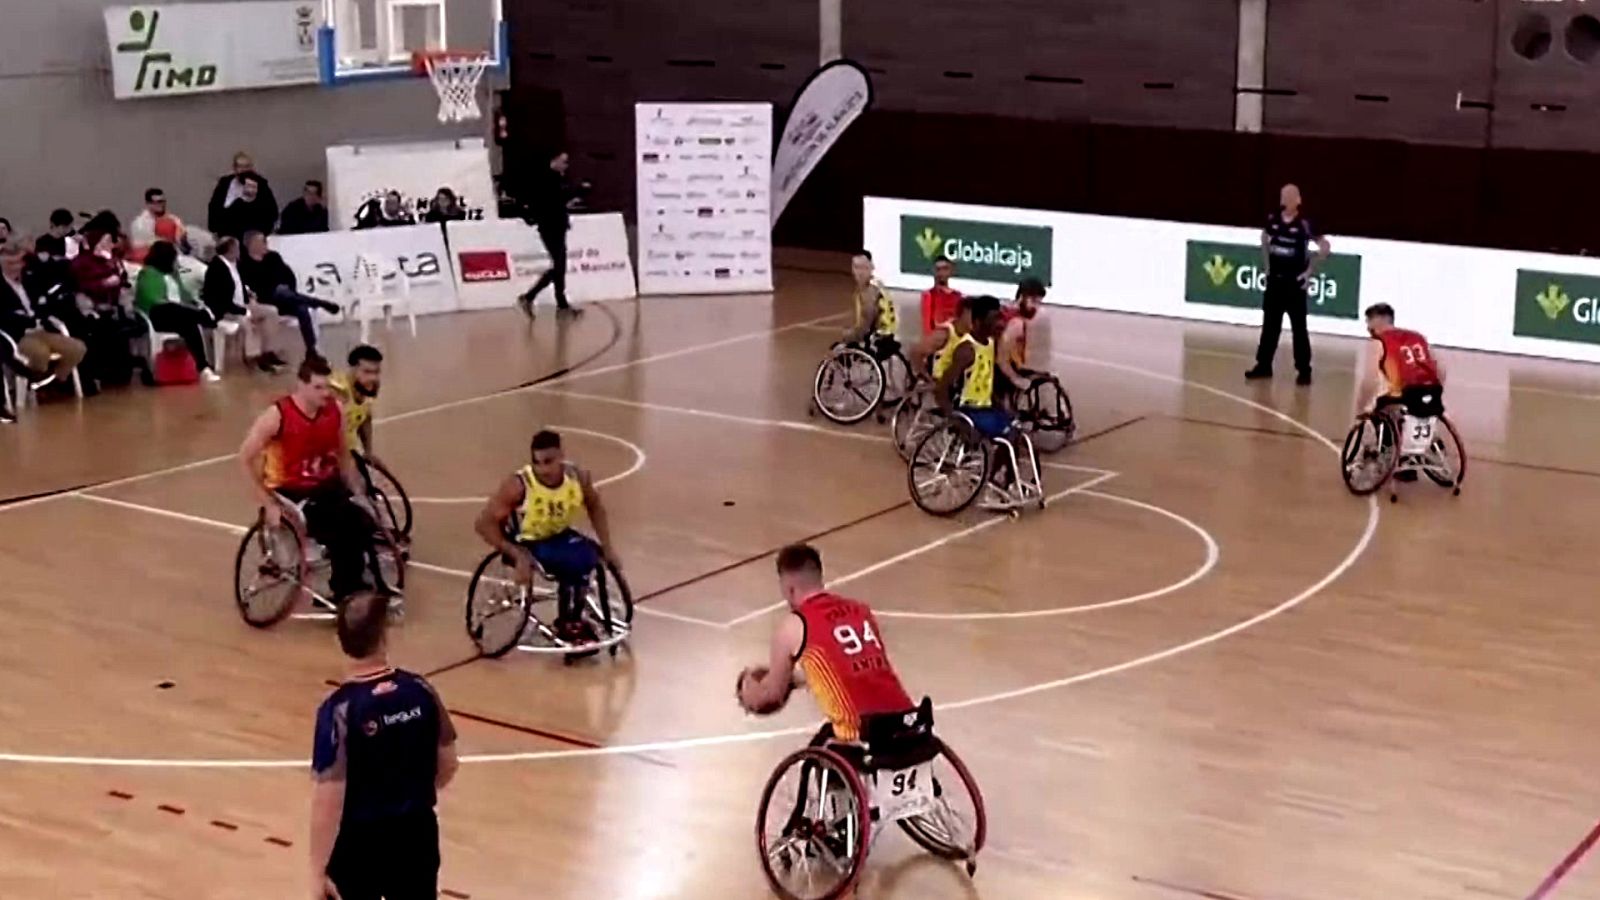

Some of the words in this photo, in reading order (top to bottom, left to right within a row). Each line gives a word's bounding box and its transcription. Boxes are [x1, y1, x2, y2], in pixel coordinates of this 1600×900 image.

[944, 238, 1032, 273] Globalcaja
[1236, 265, 1337, 305] Gloaja
[1573, 297, 1600, 324] Gl
[1400, 342, 1426, 364] 33
[834, 620, 882, 655] 94
[892, 769, 917, 796] 94
